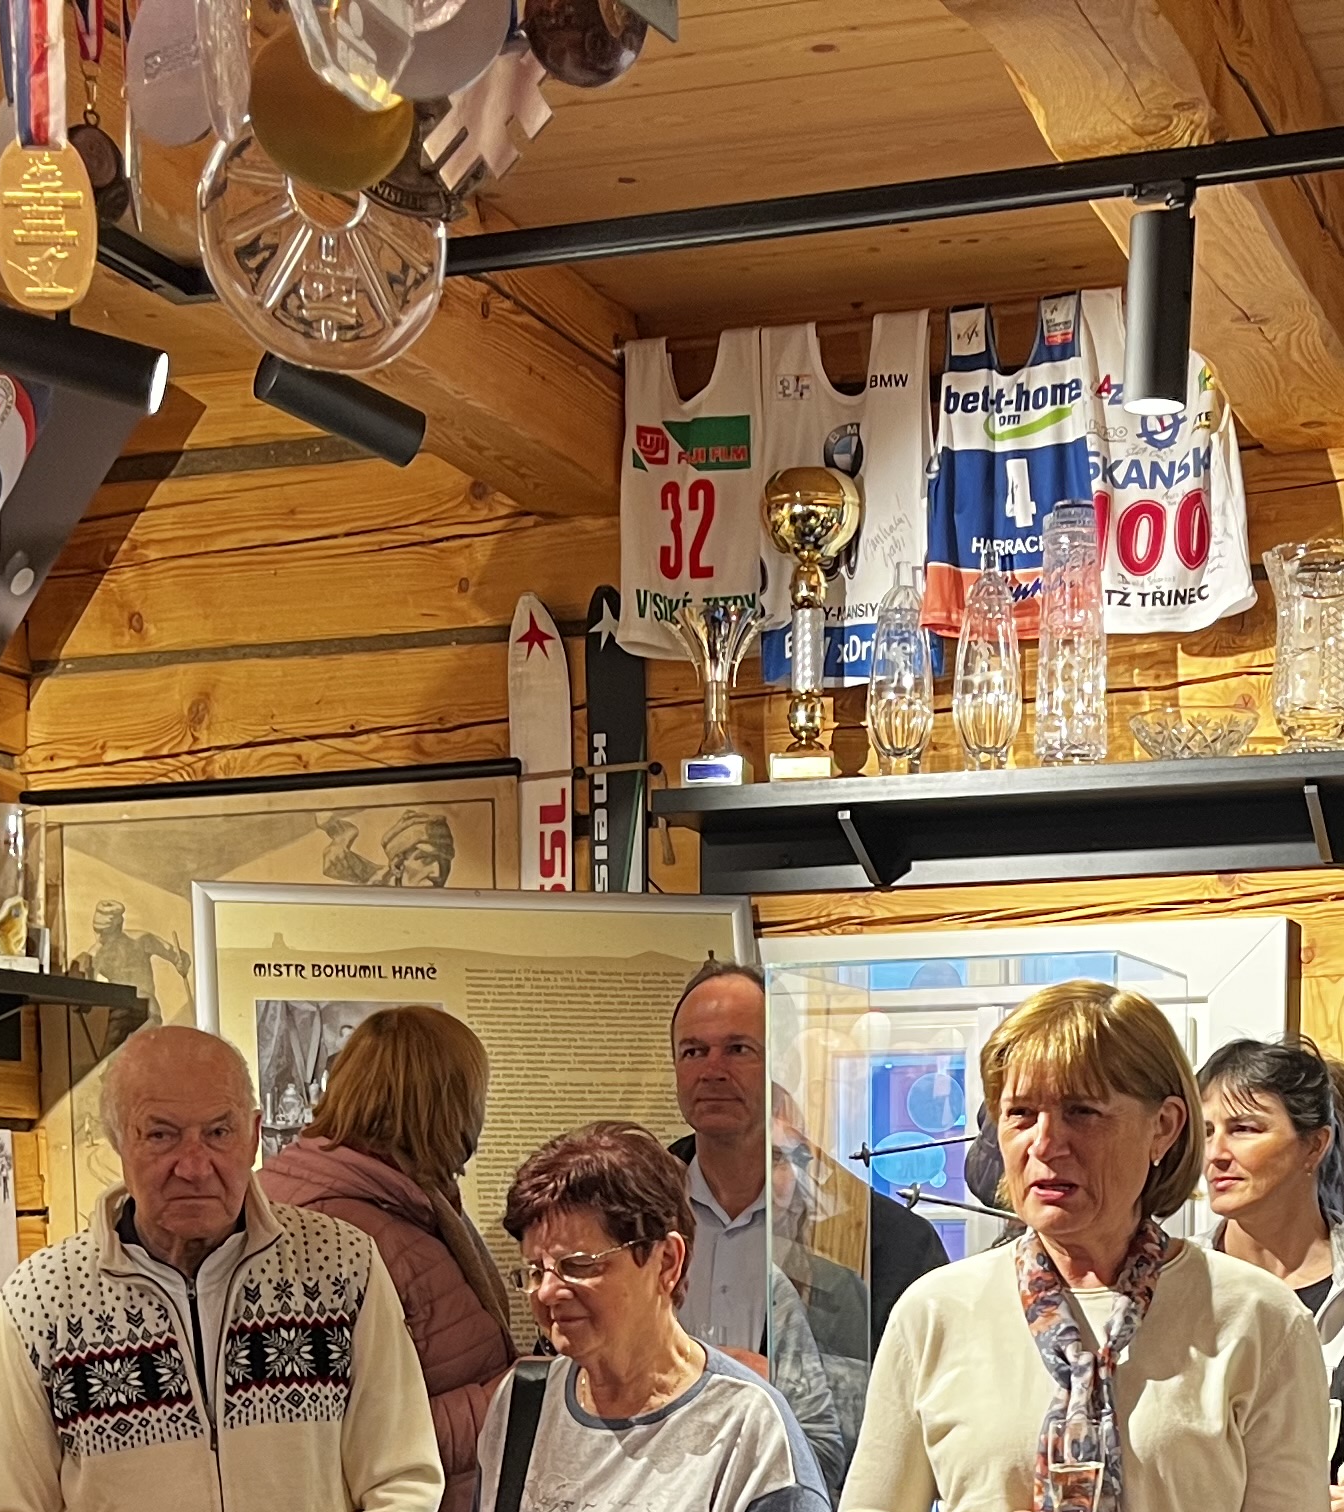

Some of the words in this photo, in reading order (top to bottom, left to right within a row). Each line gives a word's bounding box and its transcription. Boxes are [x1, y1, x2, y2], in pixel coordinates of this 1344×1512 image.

[869, 374, 909, 389] BMW
[943, 376, 1083, 415] bett-home
[998, 413, 1021, 427] om
[709, 444, 749, 463] FILM
[1005, 458, 1038, 529] 4
[659, 478, 716, 581] 32
[1136, 584, 1210, 608] TŘINEC
[253, 963, 308, 980] MISTR
[310, 963, 388, 980] BOHUMIL
